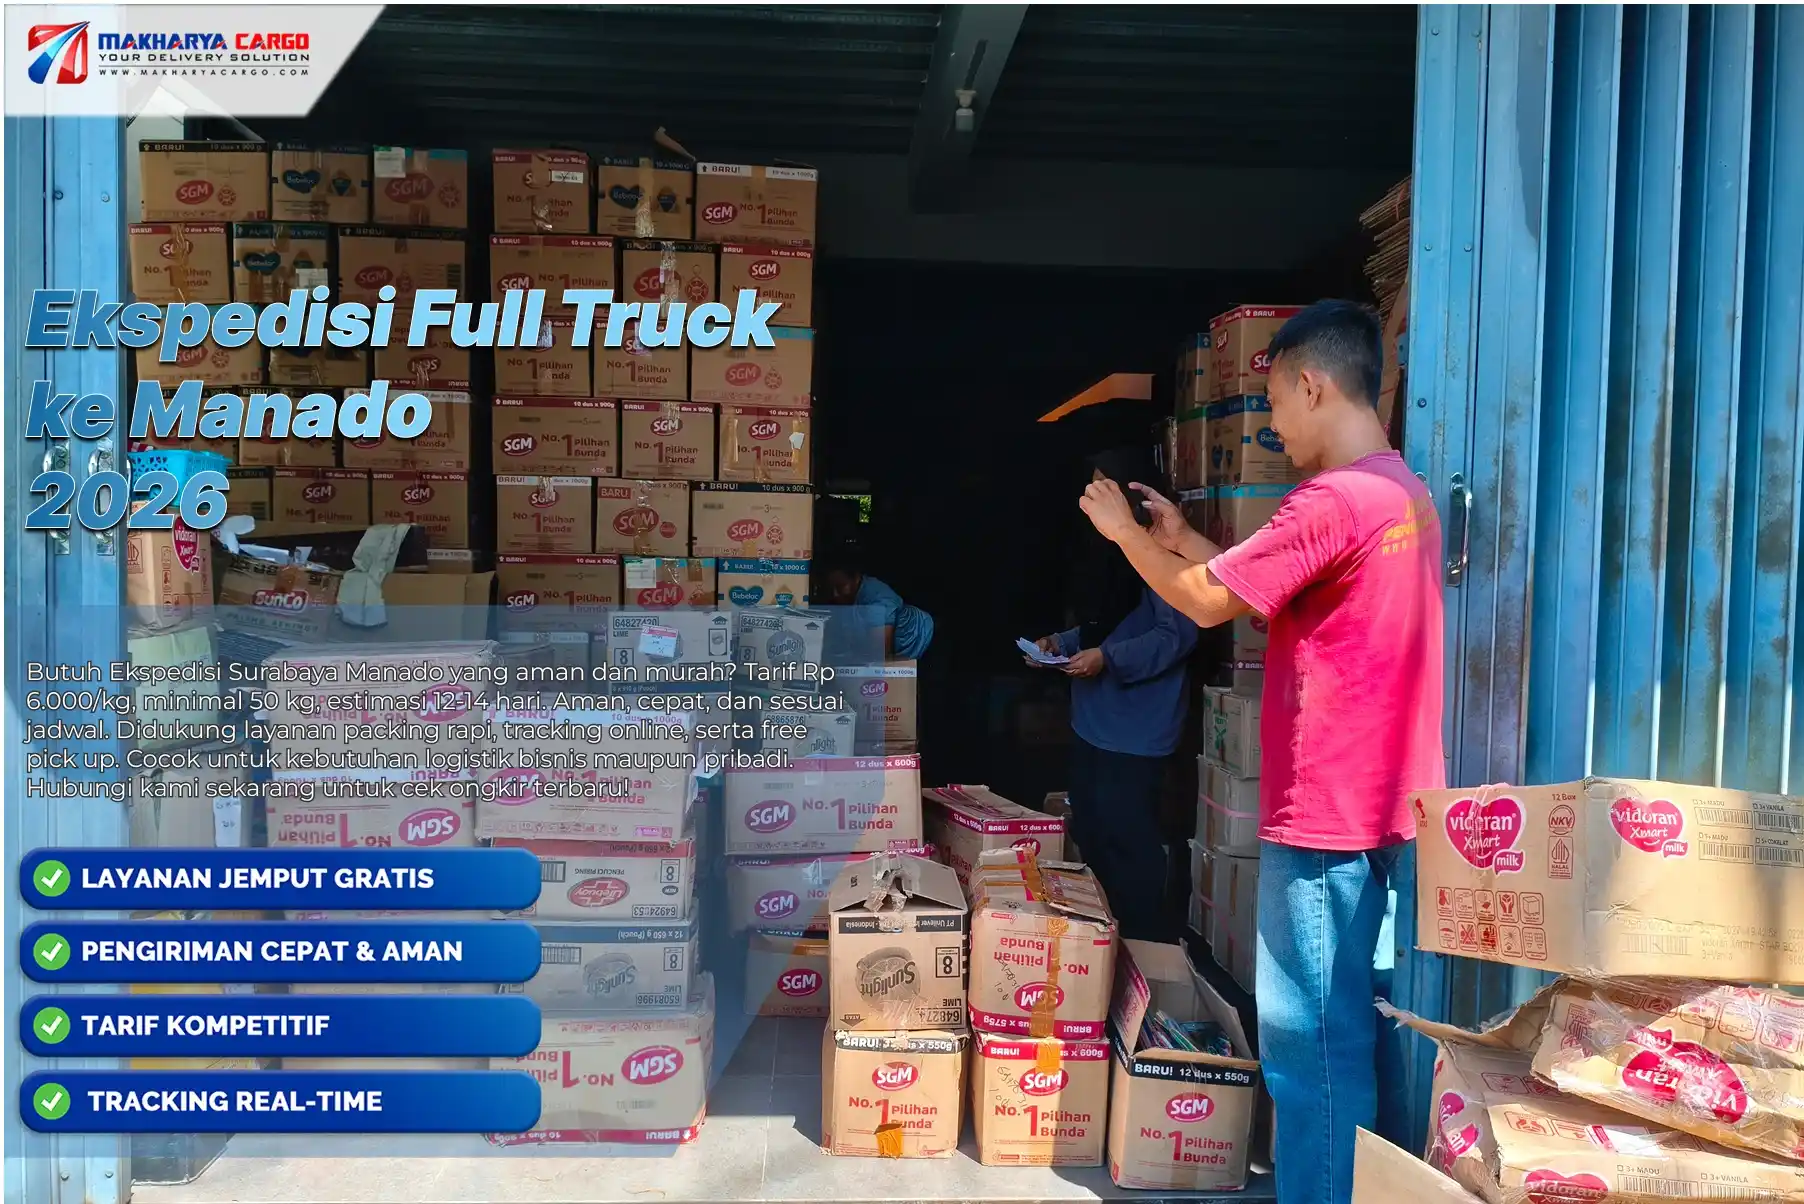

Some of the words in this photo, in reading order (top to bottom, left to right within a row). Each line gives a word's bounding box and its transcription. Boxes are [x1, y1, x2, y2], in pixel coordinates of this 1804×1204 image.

[712, 165, 740, 174] BARU!
[179, 184, 210, 200] SGM
[704, 205, 733, 219] SGM
[751, 422, 777, 435] SGM
[504, 438, 532, 451] SGM
[541, 434, 559, 443] No.
[561, 434, 572, 456] 1
[574, 438, 610, 447] Pilihan
[574, 448, 606, 457] Bunda
[710, 482, 738, 490] BARU!
[404, 488, 430, 501] SGM
[731, 523, 760, 538] SGM
[642, 587, 680, 604] SGM
[731, 592, 759, 601] Bebelac
[863, 683, 884, 694] SGM
[855, 760, 865, 768] 12
[868, 760, 884, 768] dus
[894, 759, 916, 768] 600g
[283, 813, 335, 825] Bunda
[750, 806, 789, 826] SGM
[803, 799, 828, 810] No.
[830, 799, 846, 830] 1
[848, 804, 898, 814] Pilihan
[1550, 816, 1573, 826] NKV
[1613, 808, 1677, 826] vidoran
[407, 818, 453, 841] SGM
[848, 819, 893, 830] Bunda
[278, 830, 337, 845] Pilihan
[1630, 826, 1668, 840] Xmart
[1464, 834, 1500, 850] Xmart
[1665, 843, 1685, 853] milk
[1496, 855, 1520, 867] milk
[846, 921, 875, 929] Indonesia
[922, 920, 947, 928] Unilever
[618, 929, 645, 940] (Pouch)
[1000, 937, 1045, 950] Bunda
[942, 956, 953, 975] 8
[993, 952, 1043, 968] Pilihan
[1063, 963, 1089, 975] No.
[586, 965, 638, 994] Sunlight
[782, 974, 817, 990] SGM
[860, 961, 916, 996] Sunlight
[942, 998, 962, 1006] LIME
[983, 1015, 1007, 1027] 575g
[1063, 1024, 1092, 1033] BARU!
[990, 1046, 1020, 1056] BARU!
[1080, 1049, 1103, 1058] 600g
[630, 1054, 677, 1080] SGM
[1134, 1064, 1173, 1076] BARU!
[1179, 1068, 1192, 1077] 12
[1194, 1069, 1213, 1079] dus
[1215, 1072, 1222, 1080] x
[1224, 1072, 1250, 1083] 550g
[877, 1066, 912, 1084] SGM
[1024, 1072, 1062, 1089] SGM
[1171, 1099, 1208, 1115] SGM
[995, 1104, 1021, 1116] No.
[1023, 1106, 1038, 1136] 1
[1041, 1111, 1091, 1122] Pilihan
[646, 1131, 680, 1141] BARU!
[1041, 1127, 1087, 1137] Bunda
[1140, 1127, 1166, 1140] No.
[1168, 1131, 1182, 1161] 1
[1184, 1137, 1233, 1151] Pilihan
[1184, 1153, 1227, 1164] Bunda
[1637, 1166, 1660, 1176] MADU
[1720, 1175, 1749, 1184] VANILA
